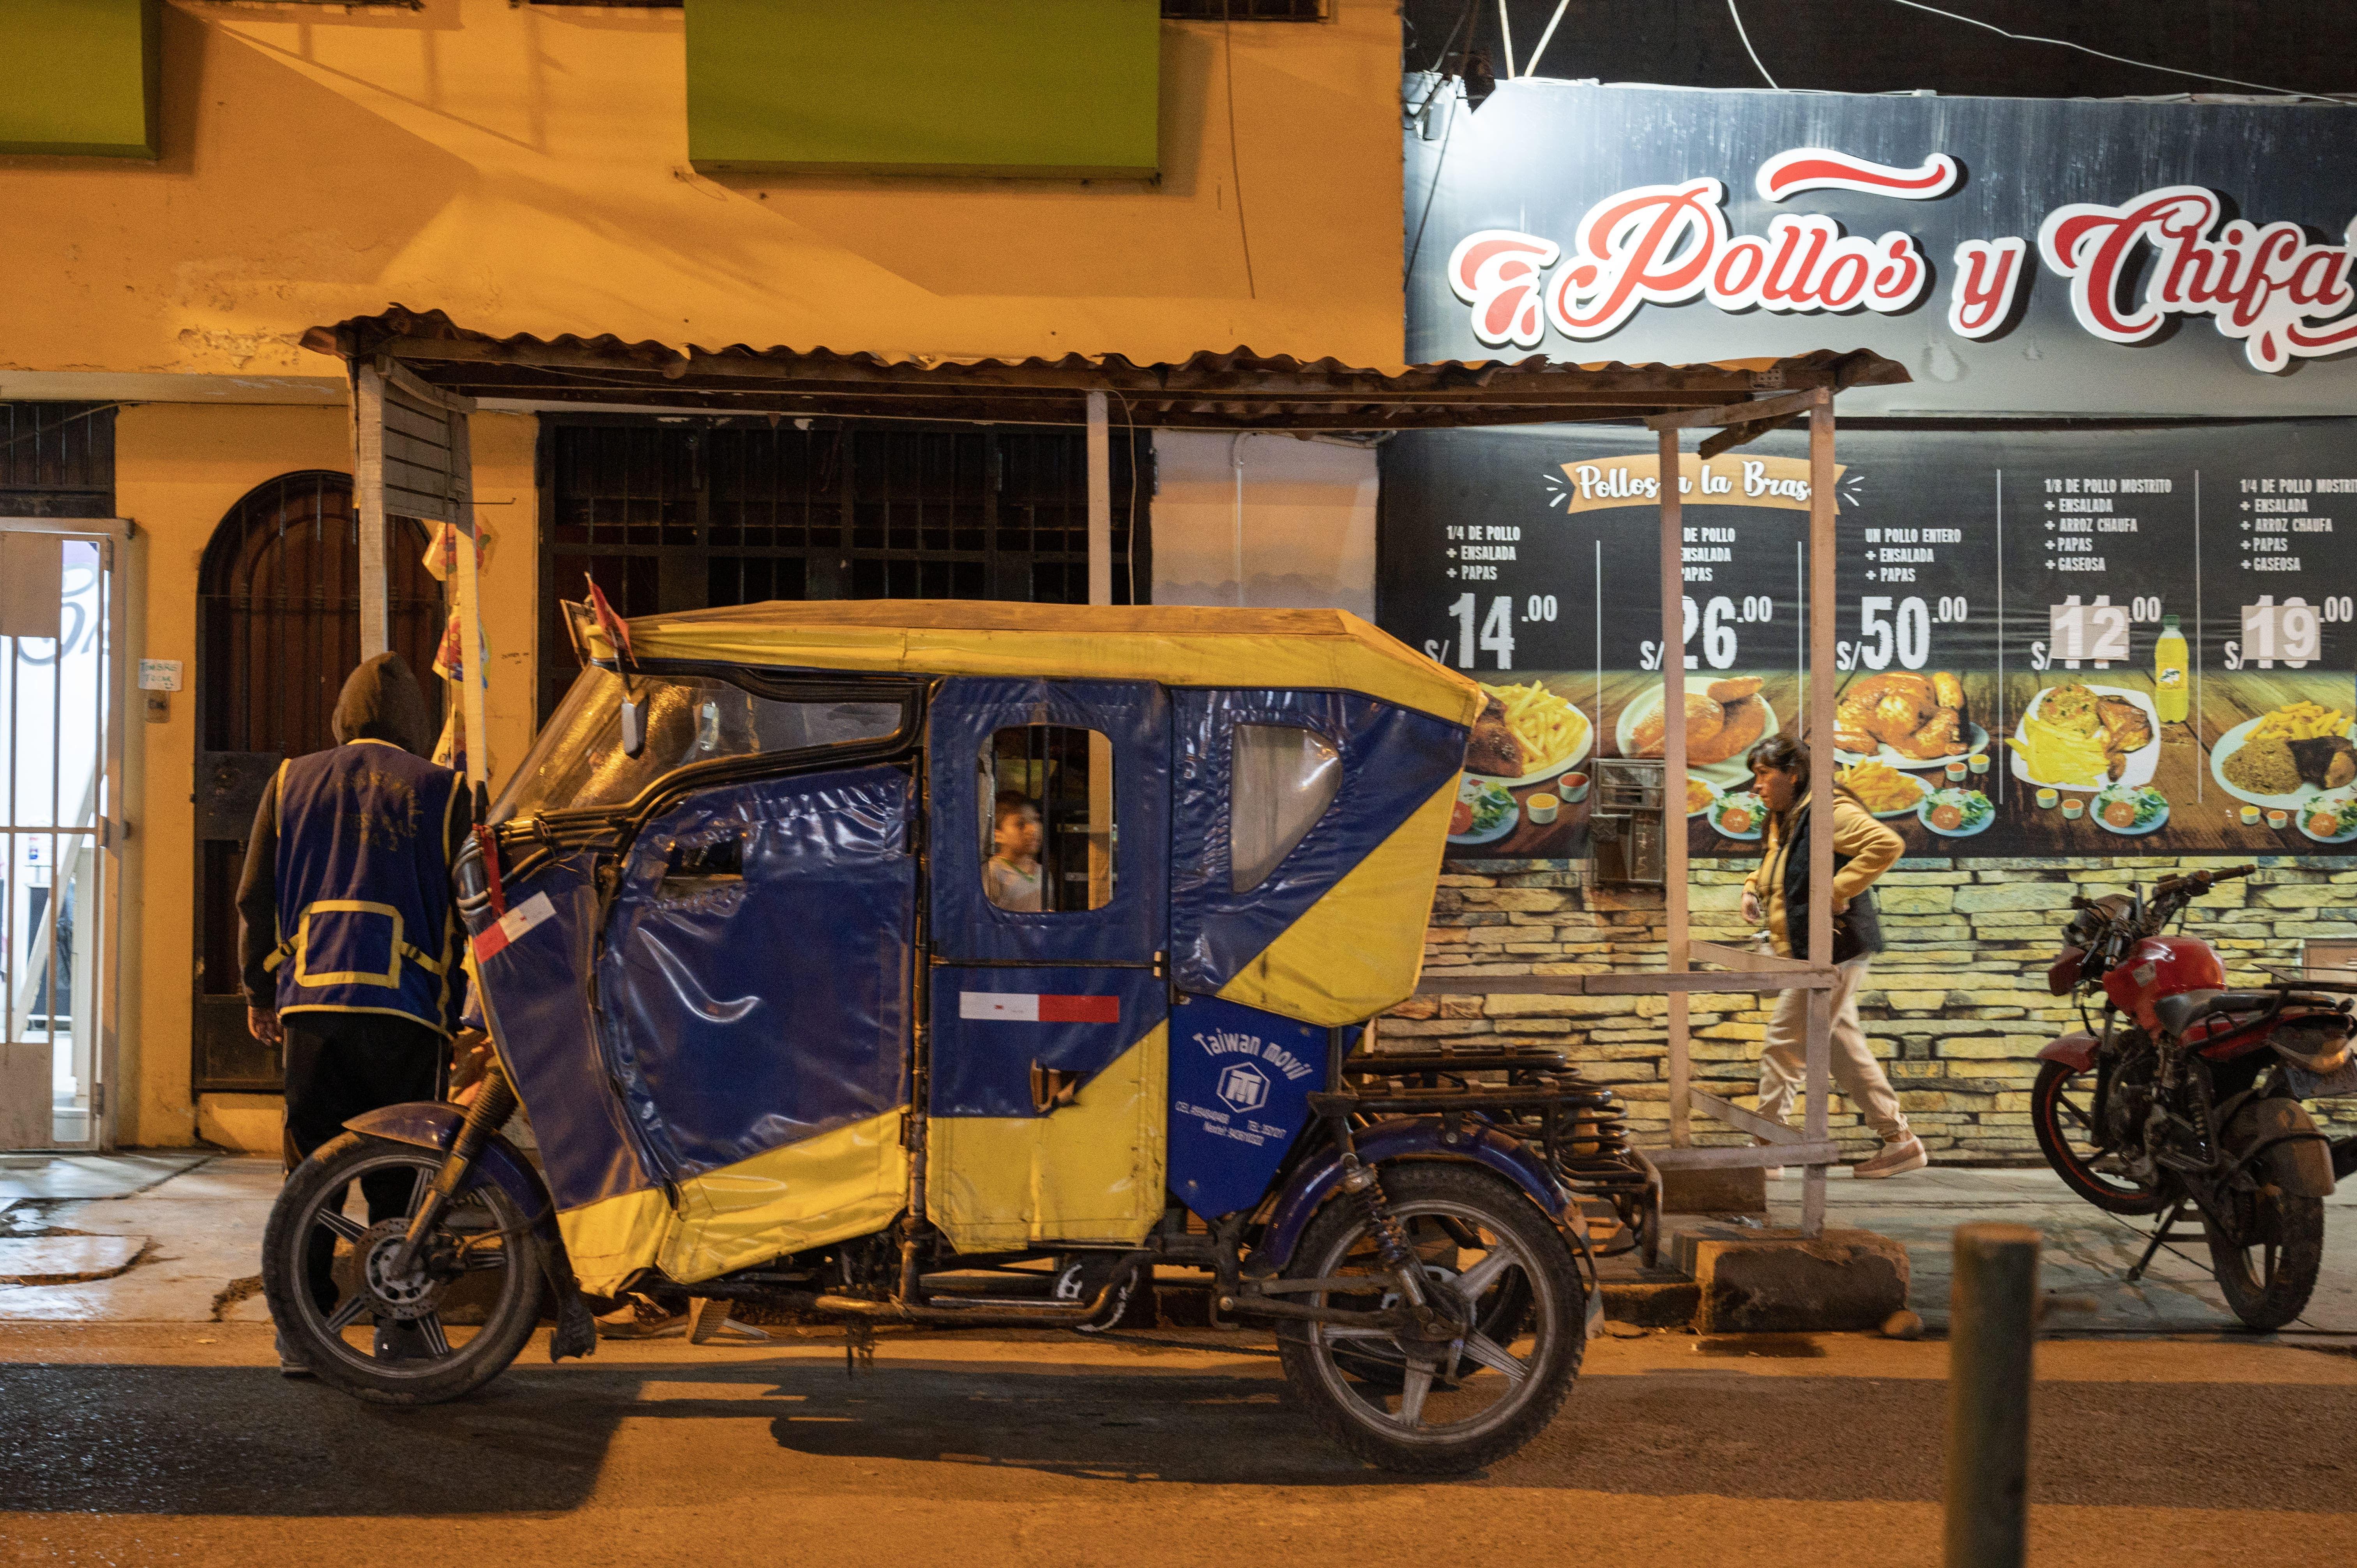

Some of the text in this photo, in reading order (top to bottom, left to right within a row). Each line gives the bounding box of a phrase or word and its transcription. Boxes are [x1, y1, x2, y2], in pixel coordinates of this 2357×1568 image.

[1552, 182, 2351, 337] Pollos y Chifa
[1575, 465, 1661, 499] Pollos
[1701, 464, 1732, 494] la
[1741, 461, 1811, 501] Bras
[2065, 479, 2080, 493] DE
[2083, 479, 2117, 493] POLLO
[2120, 479, 2172, 493] MOSTRITO
[2261, 479, 2276, 493] DE
[2279, 479, 2312, 493] POLLO
[2059, 498, 2113, 512] ENSALADA
[2255, 498, 2308, 512] ENSALADA
[2060, 518, 2093, 532] ARROZ
[2097, 518, 2138, 532] CHAUFA
[2255, 518, 2288, 532] ARROZ
[2292, 518, 2333, 532] CHAUFA
[1446, 526, 1521, 541] 1/4 DE POLLO
[1683, 527, 1735, 542] DE POLLO
[1865, 528, 1961, 543] UN POLLO ENTERO
[2057, 537, 2093, 551] PAPAS
[2253, 537, 2288, 552] PAPAS
[1461, 546, 1516, 560] ENSALADA
[1880, 548, 1934, 562] ENSALADA
[2058, 557, 2106, 571] GASEOSA
[2253, 557, 2301, 571] GASEOSA
[1462, 565, 1497, 580] PAPAS
[1880, 567, 1916, 582] PAPAS
[1192, 1028, 1261, 1056] Taiwan
